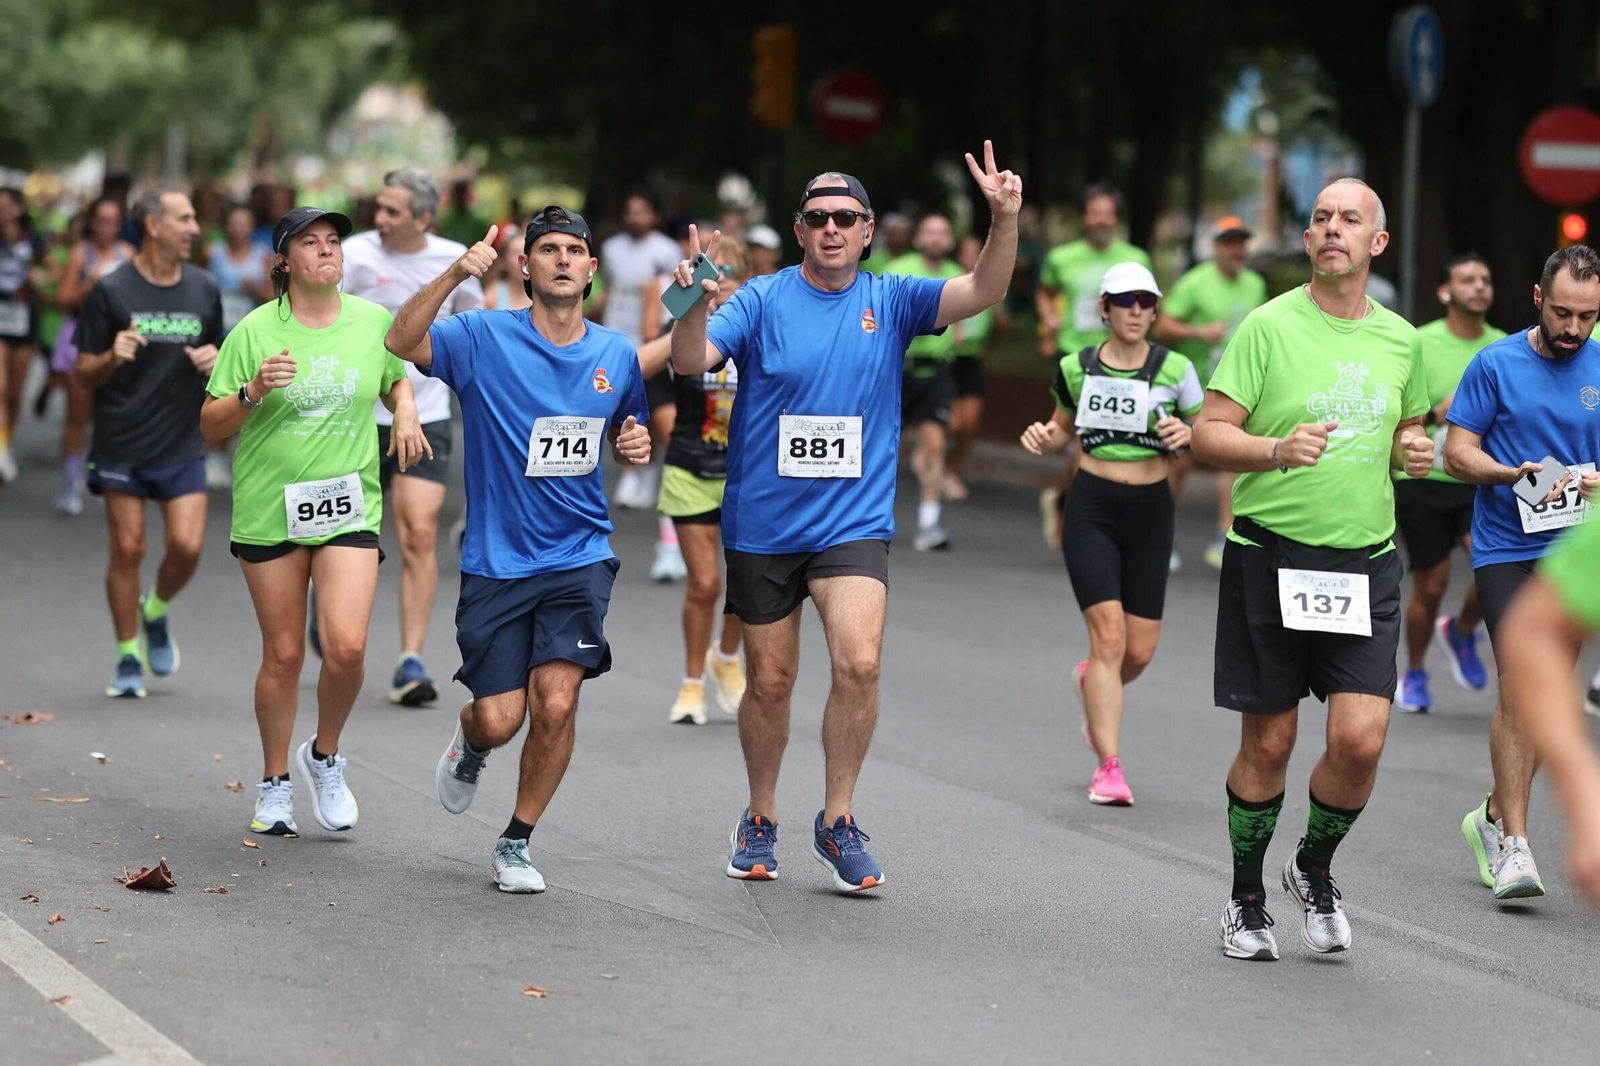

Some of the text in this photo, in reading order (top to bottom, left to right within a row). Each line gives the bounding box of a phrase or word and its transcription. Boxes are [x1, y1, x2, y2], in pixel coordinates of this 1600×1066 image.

[135, 317, 203, 336] CHICAGO
[1089, 395, 1135, 415] 643
[539, 437, 588, 458] 714
[790, 437, 845, 459] 881
[297, 495, 352, 522] 945
[1293, 592, 1352, 615] 137
